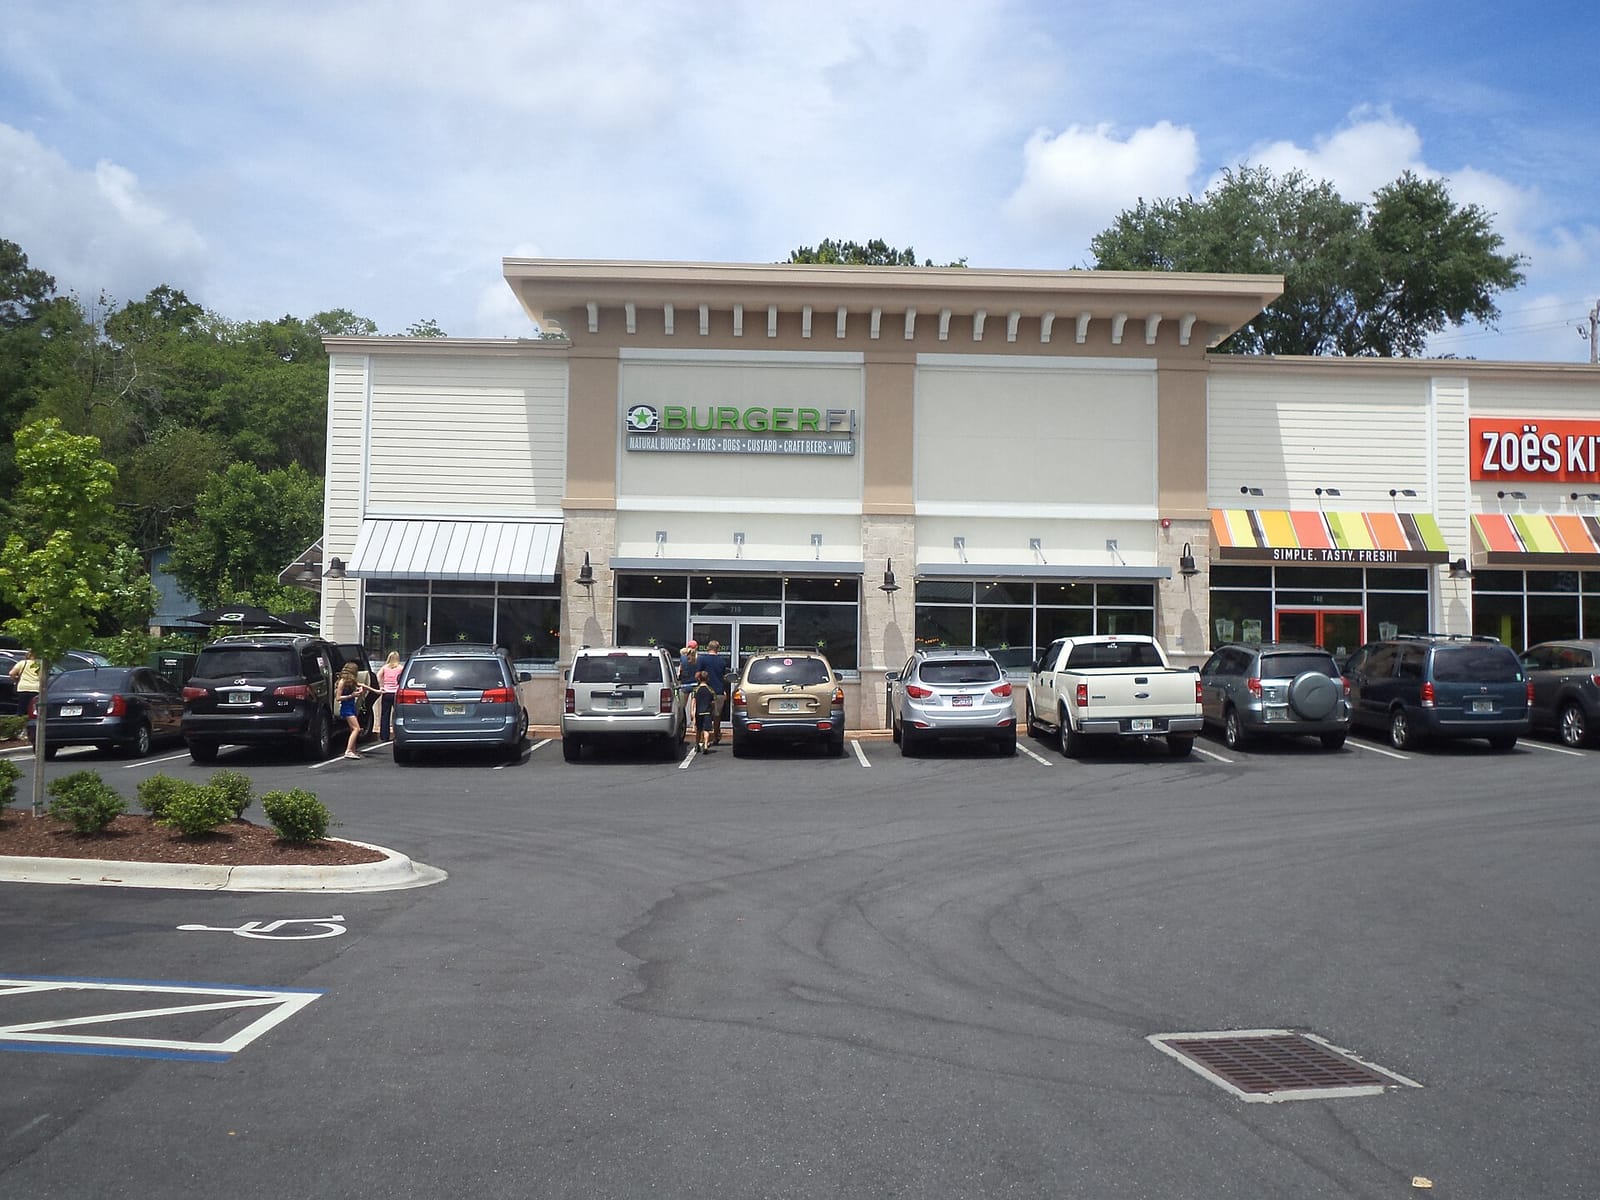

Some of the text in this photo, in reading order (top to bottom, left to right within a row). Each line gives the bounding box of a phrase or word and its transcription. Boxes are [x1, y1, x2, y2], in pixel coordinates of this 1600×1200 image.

[663, 406, 856, 433] BURGERFI
[629, 437, 852, 454] NATURAL BURGERS FRIES DOGS CUSTARD CRAFT BEERS WINE
[1567, 436, 1600, 472] KI
[1273, 549, 1397, 562] SIMPLE. TASTY. FRESH!
